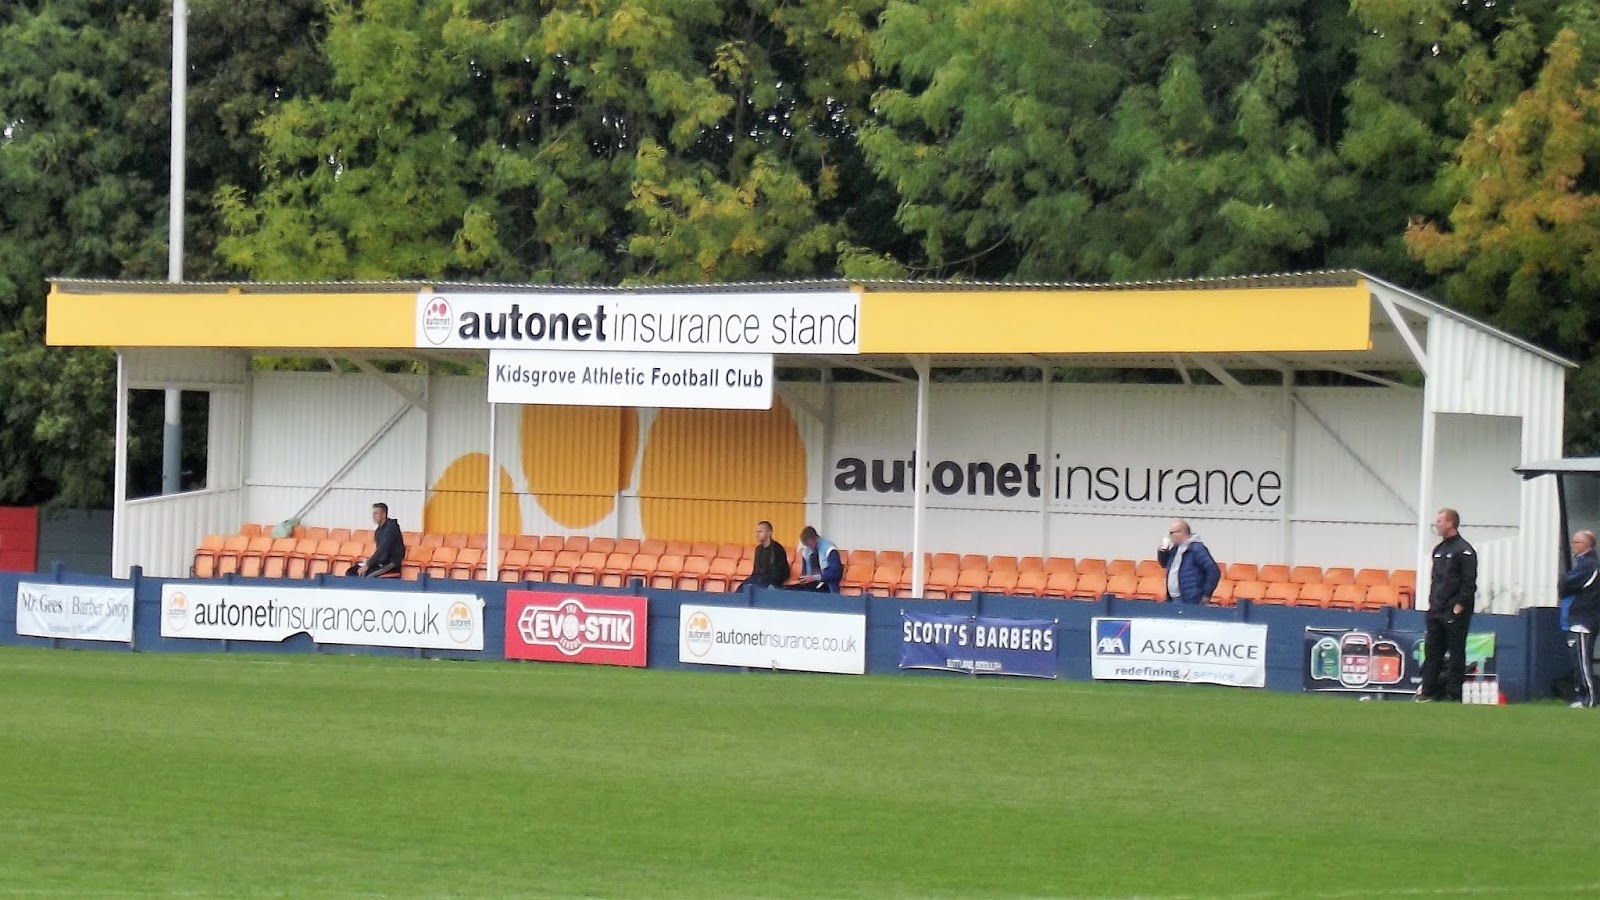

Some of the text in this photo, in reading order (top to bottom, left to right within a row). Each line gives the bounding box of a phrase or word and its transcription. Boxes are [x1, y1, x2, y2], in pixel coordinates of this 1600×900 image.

[458, 303, 857, 346] autonet insurance stand
[496, 363, 763, 389] Kidsgrove Athletic Football Club
[1055, 454, 1281, 506] insurance
[39, 593, 63, 615] Gees
[72, 595, 104, 616] Barber
[105, 597, 129, 623] Shop
[194, 597, 440, 636] autonetinsurance.co.uk
[535, 613, 631, 643] EVO-STIK
[715, 627, 857, 653] autonetinsurance.co.uk
[902, 620, 1054, 652] SCOTT'S BARBERS
[1096, 637, 1126, 654] AXA
[1140, 639, 1260, 660] ASSISTANCE
[1115, 666, 1180, 680] redefining
